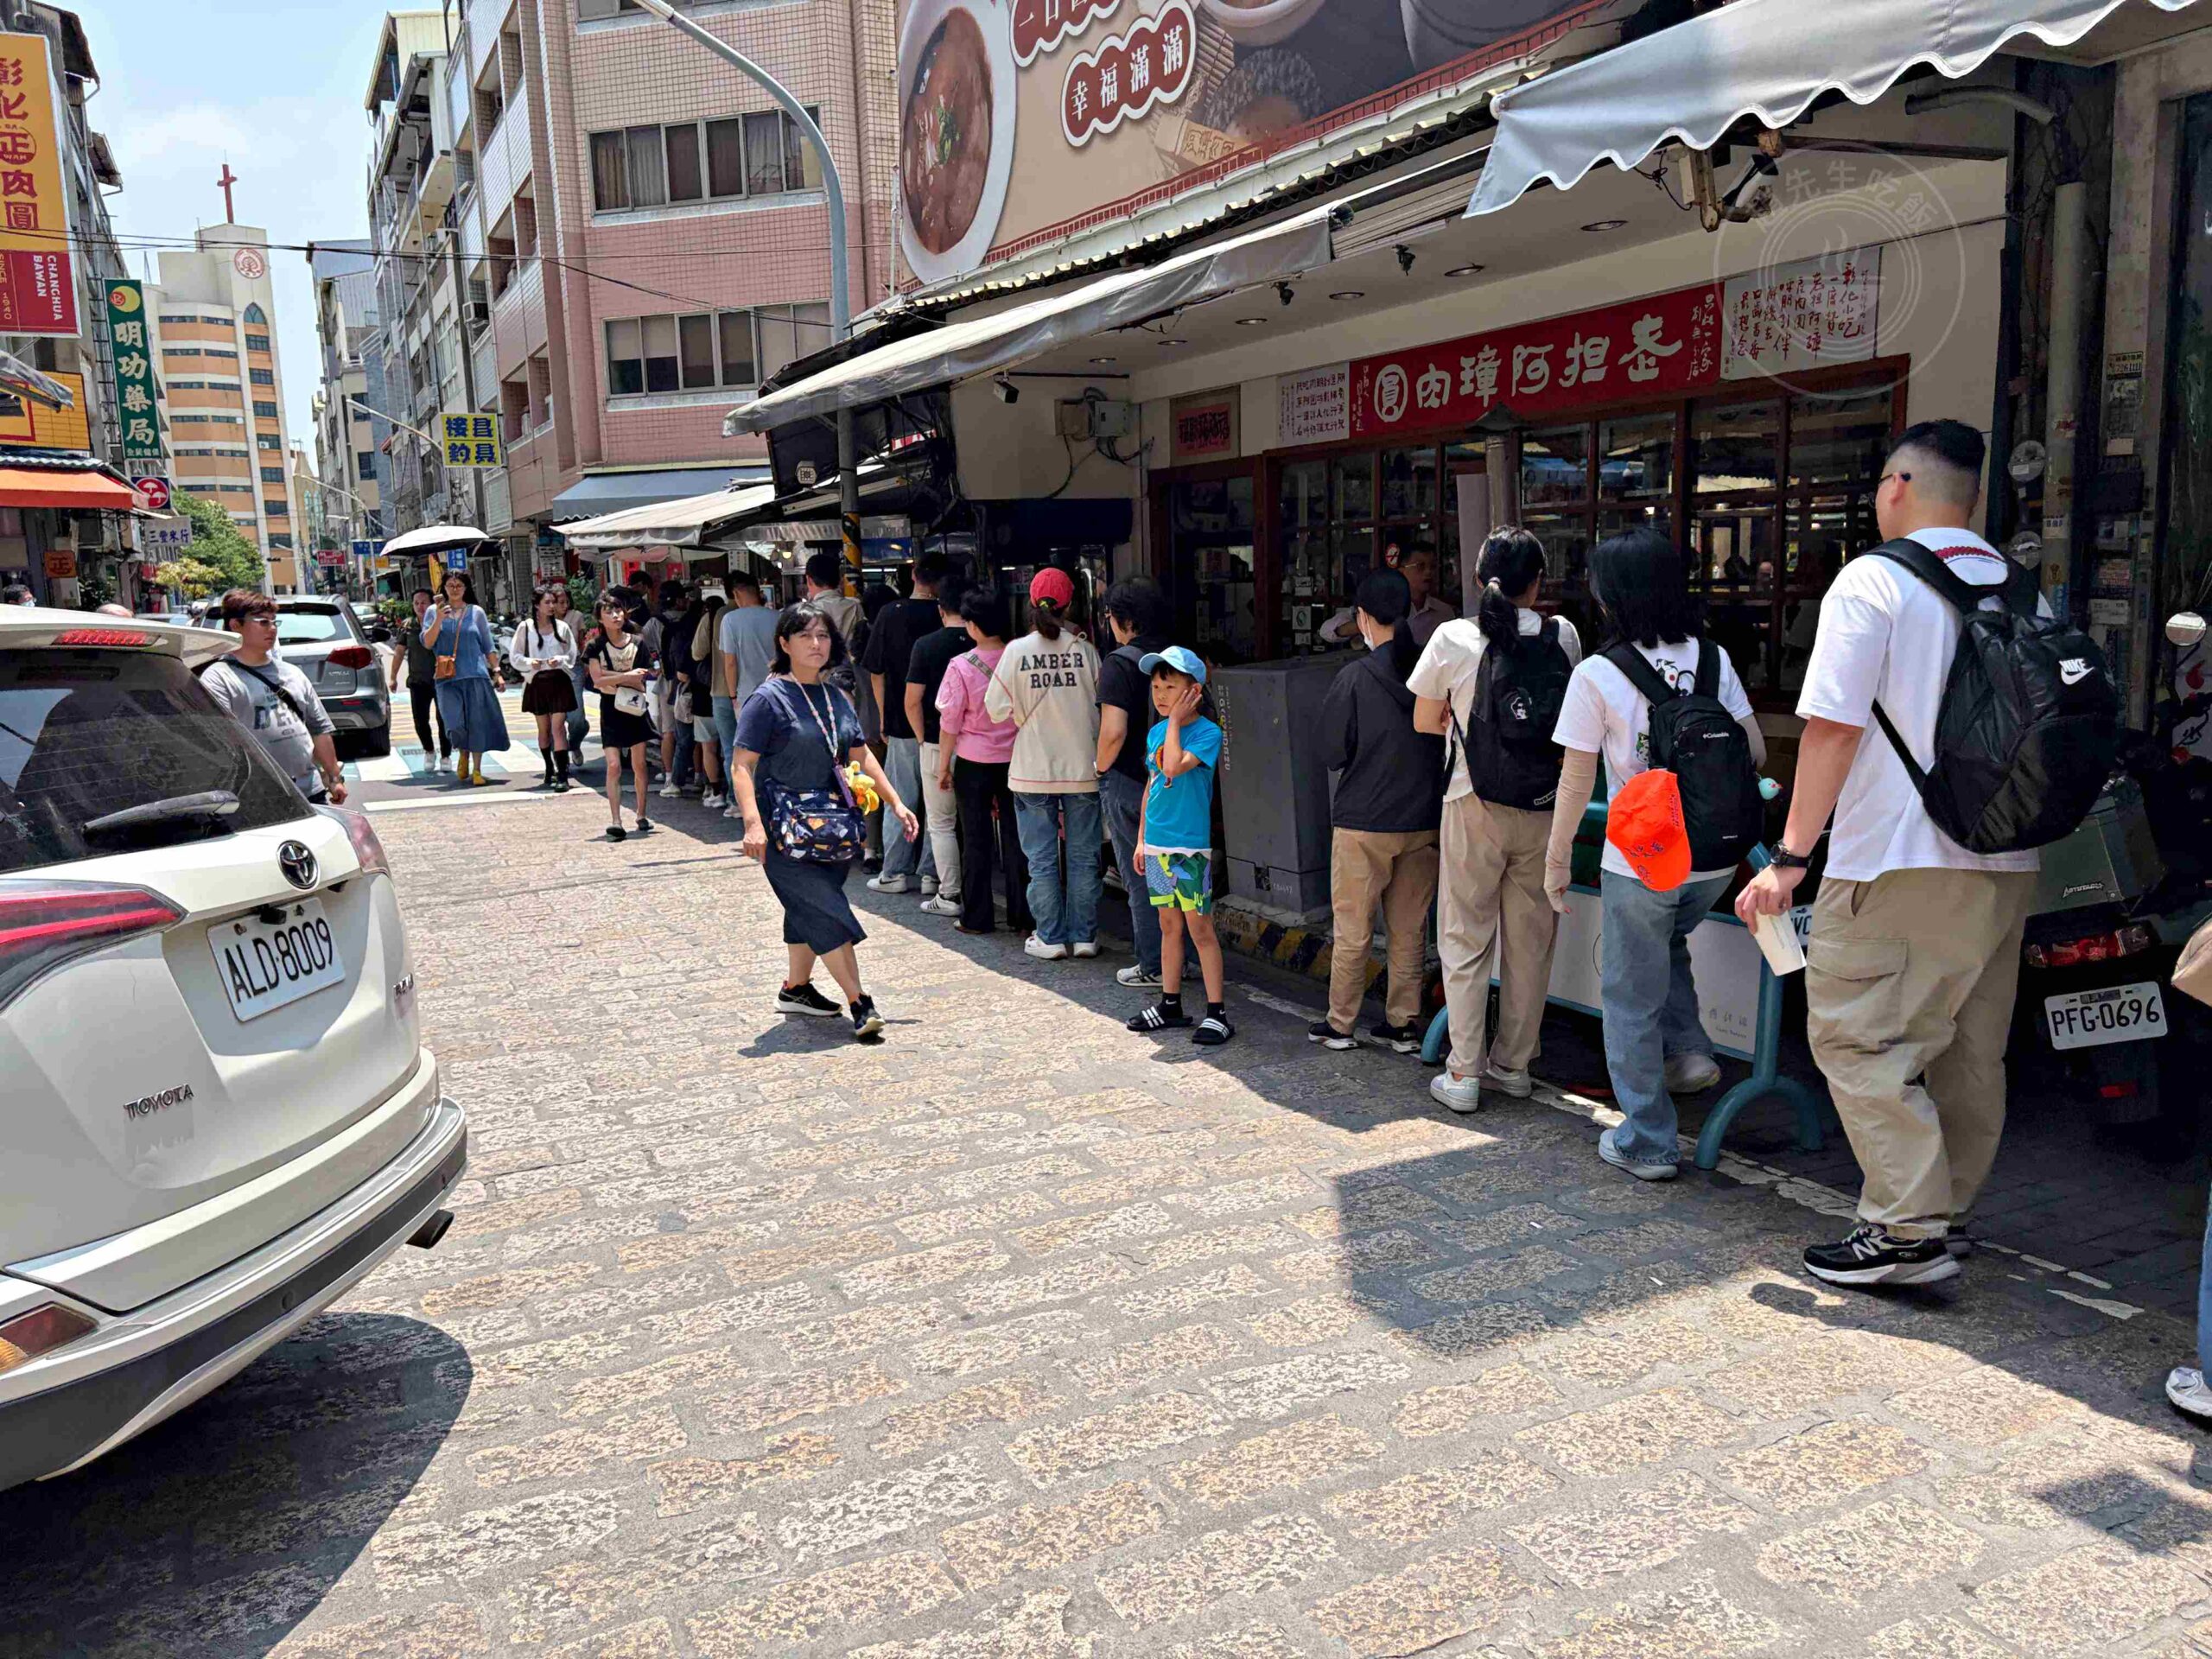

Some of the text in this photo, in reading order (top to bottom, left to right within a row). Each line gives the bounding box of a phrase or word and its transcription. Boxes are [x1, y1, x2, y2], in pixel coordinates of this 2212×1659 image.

[1070, 24, 1185, 121] 幸福滿滿
[33, 255, 47, 297] BAWAN
[47, 255, 63, 321] CHANGHUA
[114, 321, 155, 445] 明功藥局
[1020, 652, 1084, 671] AMBER
[1031, 671, 1077, 689] ROAR
[2058, 658, 2086, 672] NIKE
[124, 1084, 194, 1120] TOYOTA
